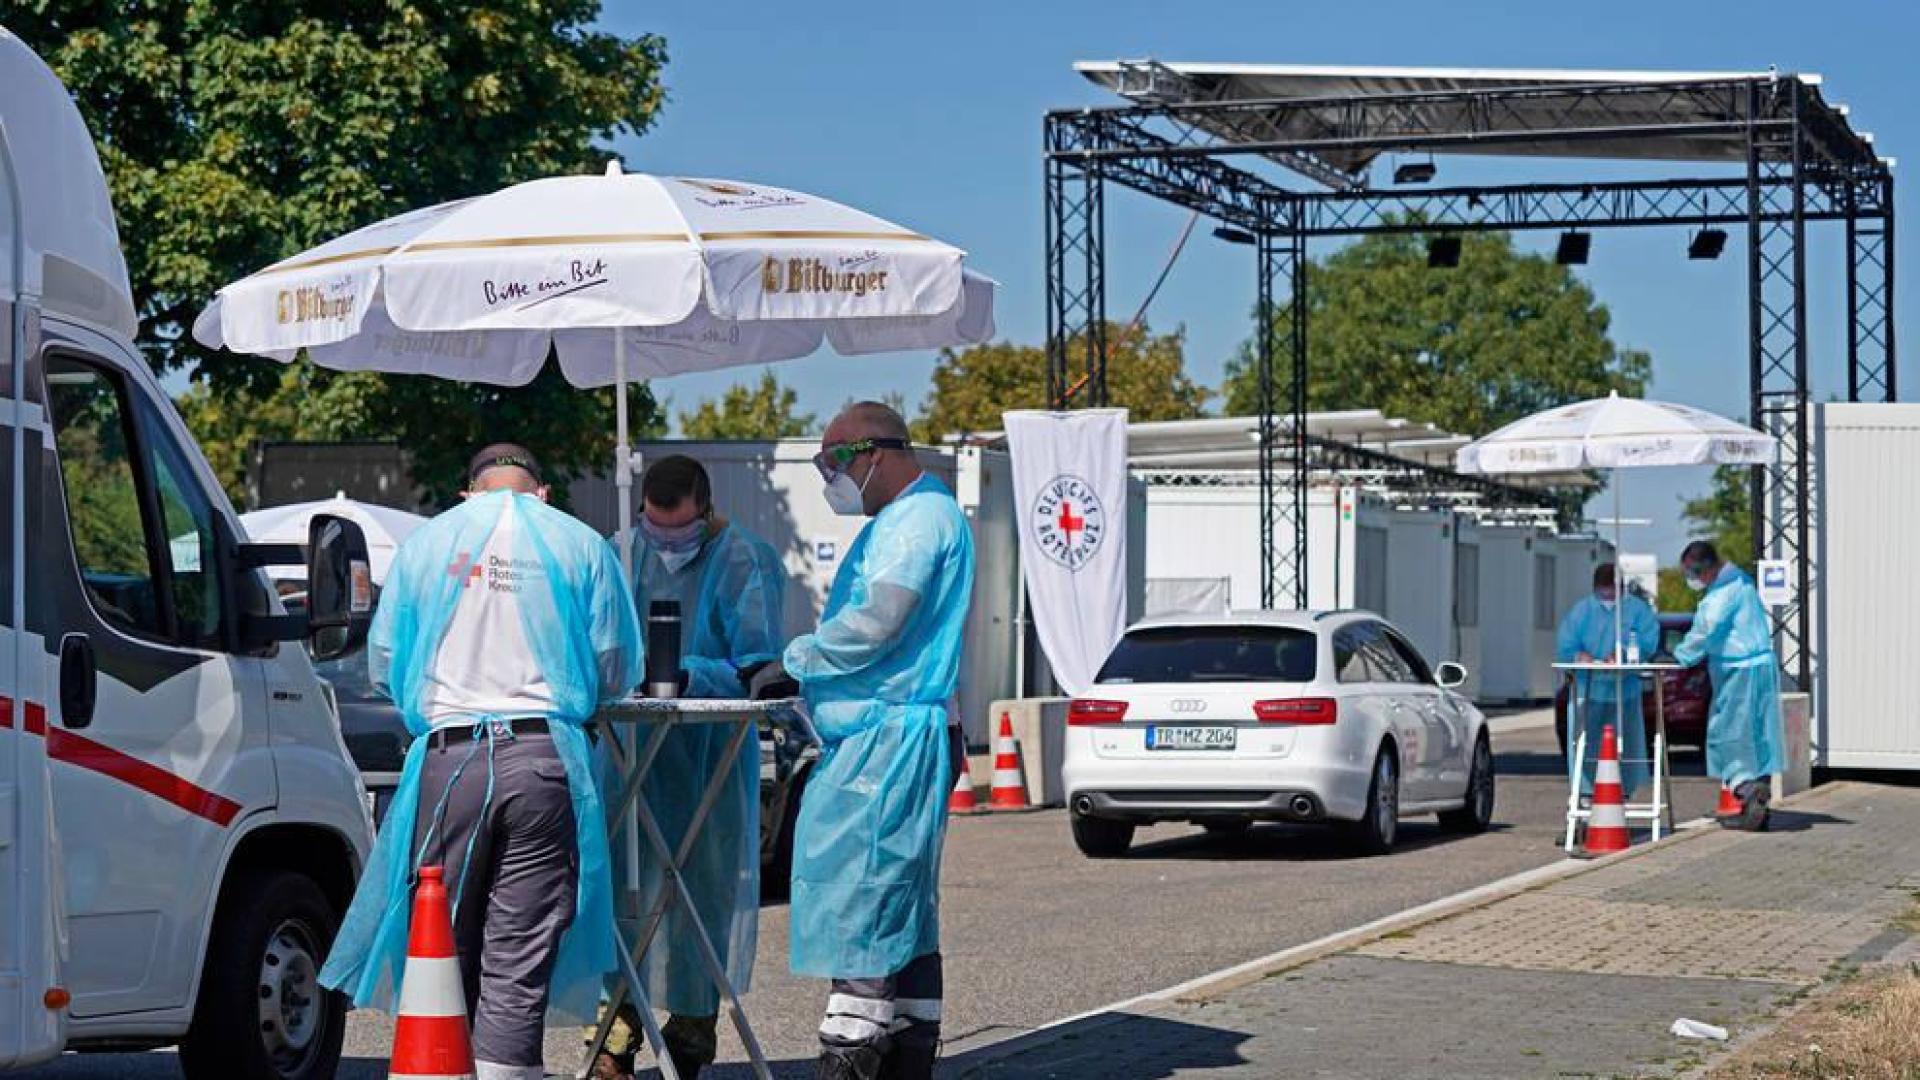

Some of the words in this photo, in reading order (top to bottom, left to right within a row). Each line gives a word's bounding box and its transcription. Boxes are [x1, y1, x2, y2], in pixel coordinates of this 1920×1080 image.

[484, 280, 530, 305] Bitte
[571, 258, 608, 282] Bit
[785, 256, 887, 297] Bitburger
[1157, 728, 1174, 743] TR
[1205, 728, 1233, 743] 204
